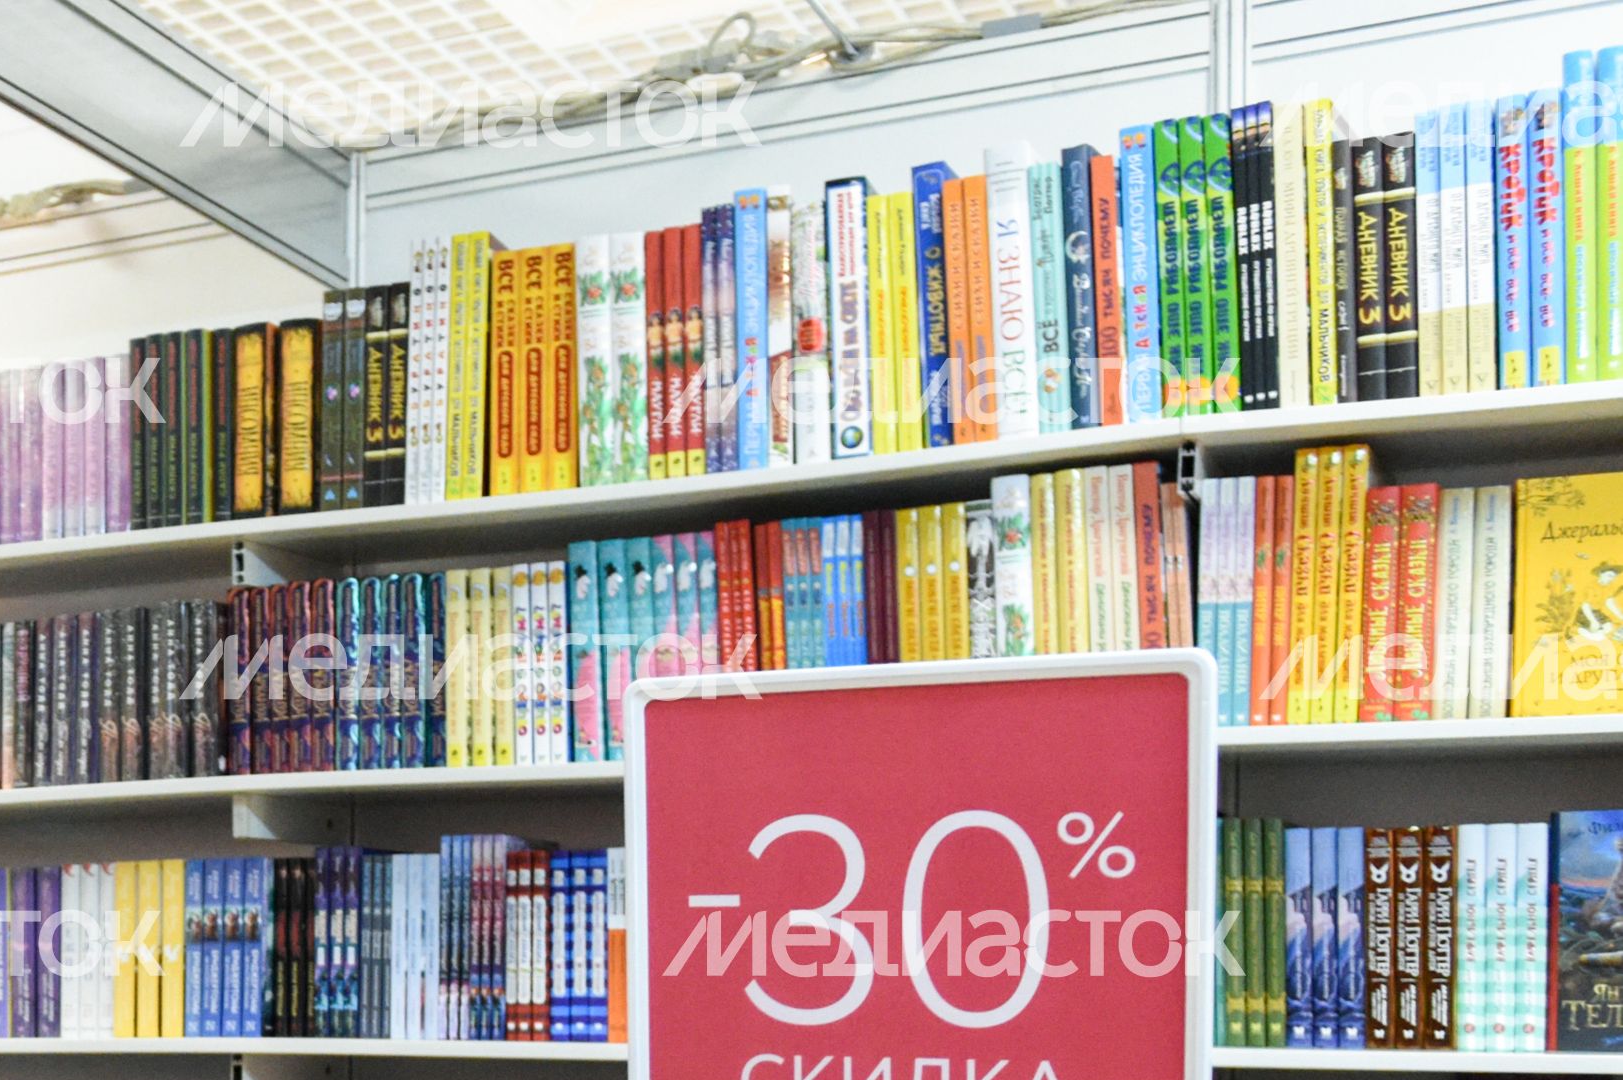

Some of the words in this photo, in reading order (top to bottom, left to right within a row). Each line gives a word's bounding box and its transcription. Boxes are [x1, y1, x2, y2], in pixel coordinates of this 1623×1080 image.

[1532, 137, 1561, 227] КРОТИК
[995, 219, 1012, 239] Я
[1097, 197, 1113, 261] ПОЧЕМУ
[1127, 153, 1148, 281] ЭНЦИКЛОПЕДИЯ
[497, 258, 516, 296] ВСЕ
[525, 255, 544, 292] ВСЕ
[553, 251, 573, 287] ВСЕ
[1357, 211, 1382, 301] ДНЕВНИК
[1387, 207, 1412, 298] ДНЕВНИК
[927, 265, 949, 357] ЖИВОТНЫХ
[997, 244, 1022, 343] ЗНАЮ
[1098, 267, 1114, 320] ТЫСЯЧ
[1131, 285, 1151, 350] ДТСКАЯ
[1357, 306, 1382, 326] 3
[1387, 304, 1410, 322] 3
[1036, 318, 1060, 355] ВСЁ
[1098, 326, 1119, 358] 100
[366, 346, 386, 423] ДНЕВНИК
[388, 343, 408, 421] ДНЕВНИК
[365, 426, 385, 443] 3
[387, 424, 405, 441] 3
[650, 380, 665, 441] МАУГЛИ
[1407, 539, 1427, 598] СКАЗКИ
[1375, 927, 1392, 977] ПОТТЕР
[1405, 927, 1422, 977] ПОТТЕР
[1436, 927, 1453, 977] ПОТТЕР
